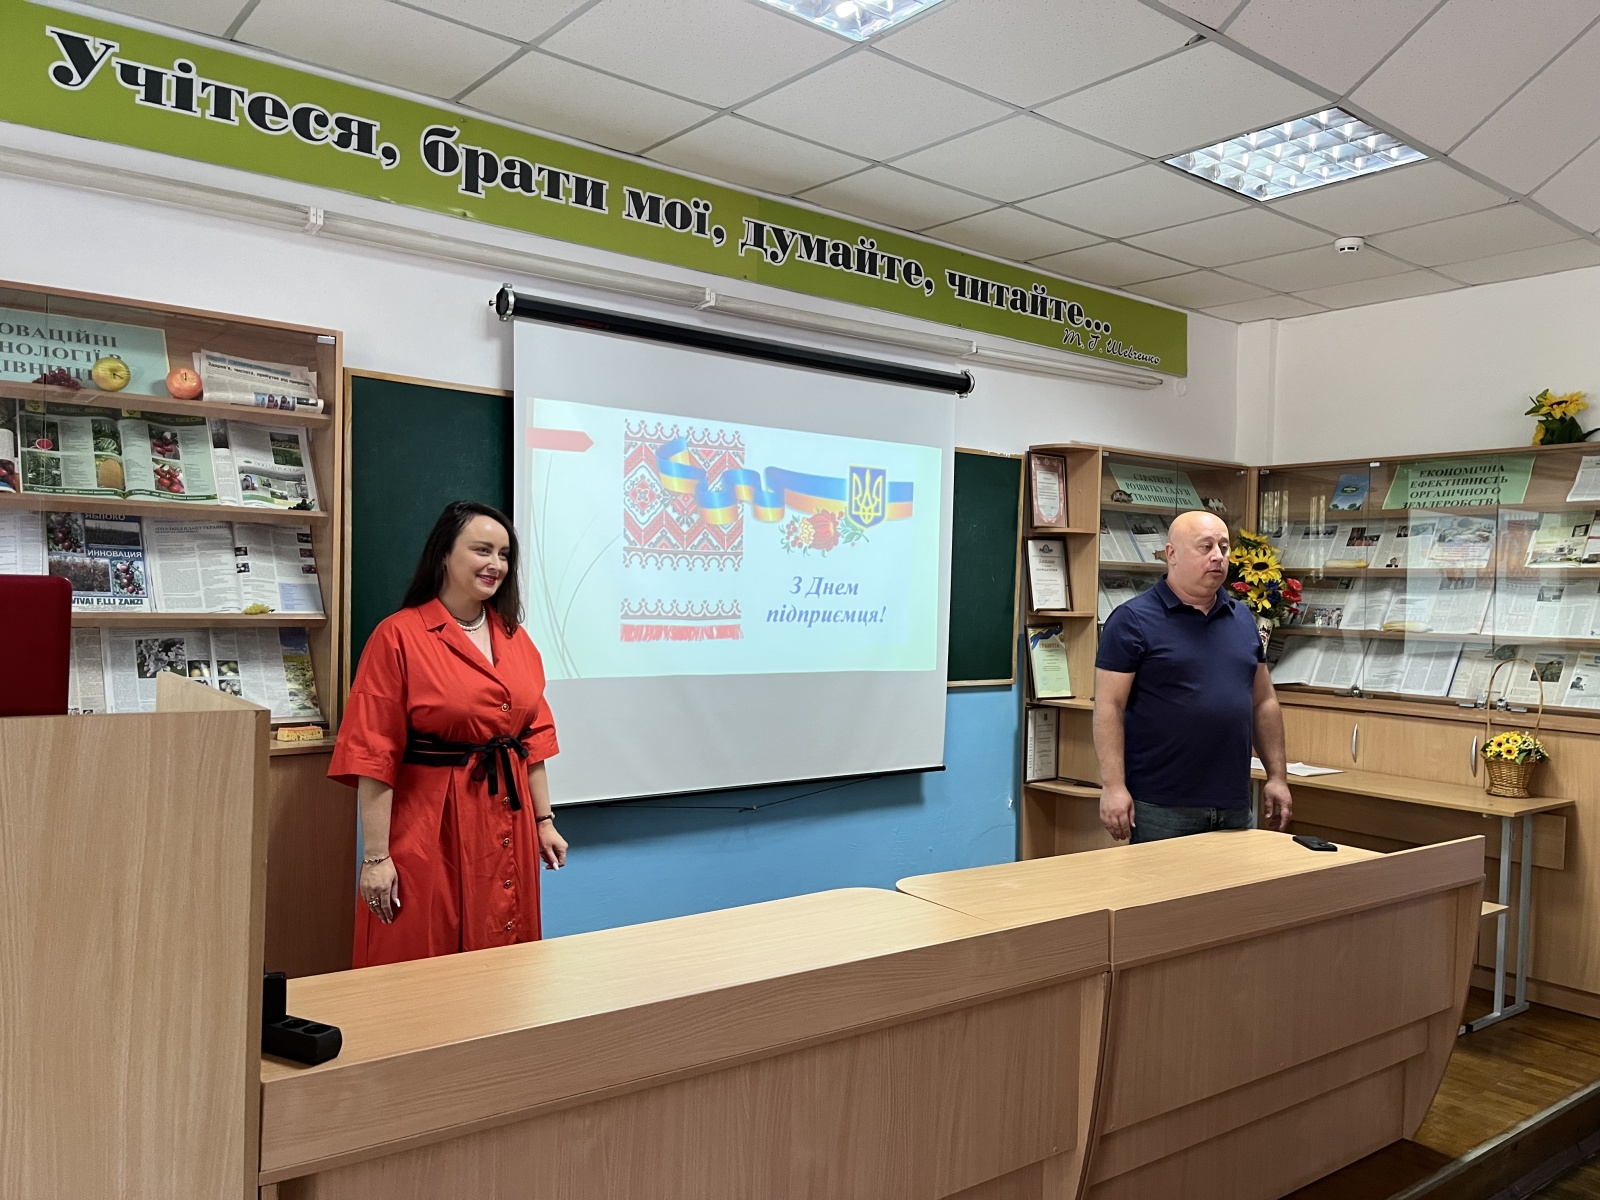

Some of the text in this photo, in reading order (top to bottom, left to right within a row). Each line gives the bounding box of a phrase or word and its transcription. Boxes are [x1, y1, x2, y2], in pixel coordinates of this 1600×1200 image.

[47, 27, 1112, 338] Учітеся, брати мої, думайте, читайте...
[0, 322, 118, 348] ОВАЦІЙНІ
[1106, 338, 1161, 365] Шевченко
[1419, 464, 1505, 478] ЕКОНОМІЧНА
[1133, 473, 1174, 485] СТРАТЕГІЯ
[1409, 475, 1508, 489] ЕФЕКТИВНІСТЬ
[1125, 482, 1163, 493] РОЗВИТКУ
[1409, 486, 1502, 499] ОРГАНІЧНОГО
[1401, 498, 1501, 510] ЗЕМЛЕРОБСТВА
[87, 549, 142, 559] ИННОВАЦИЯ
[789, 576, 859, 599] З Днем
[766, 604, 887, 628] підприємця!
